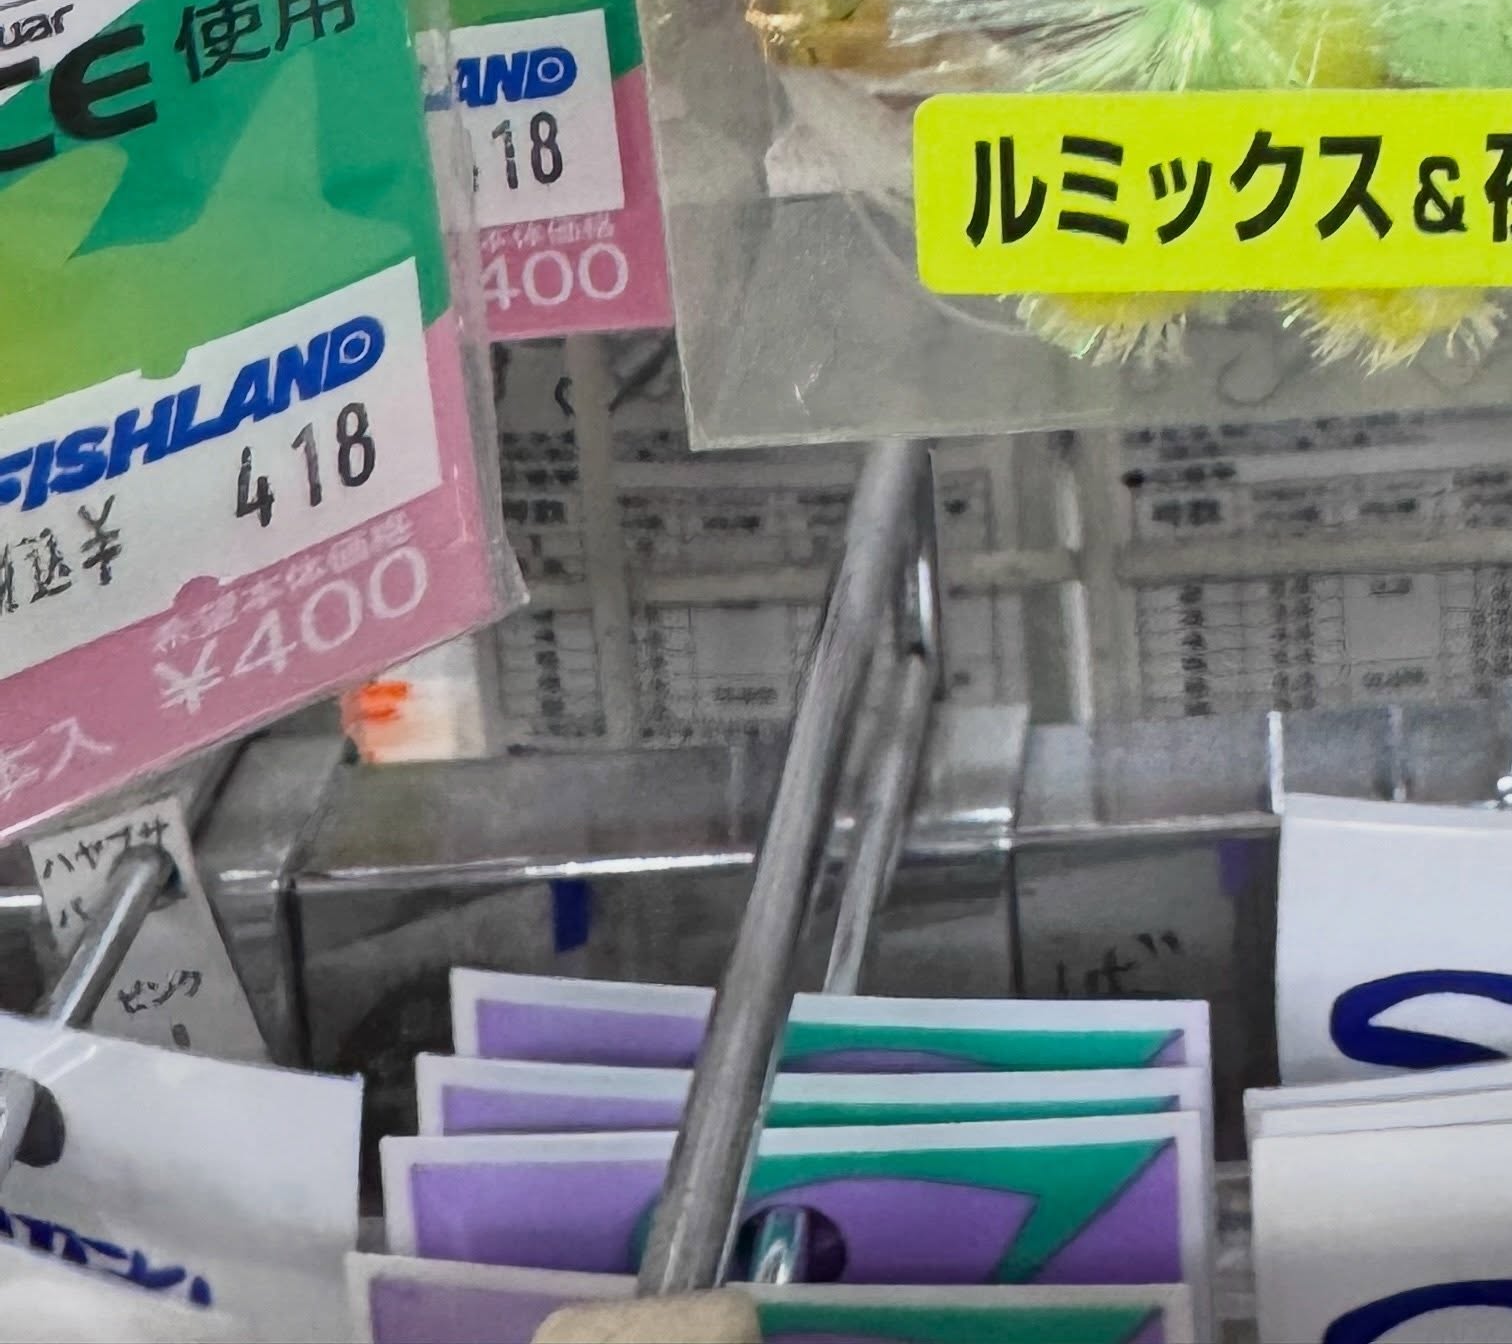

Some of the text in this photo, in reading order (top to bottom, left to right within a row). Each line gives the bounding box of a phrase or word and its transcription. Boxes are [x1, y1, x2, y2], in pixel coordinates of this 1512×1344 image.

[428, 45, 578, 109] AND
[472, 111, 564, 192] 18
[236, 401, 376, 528] 418
